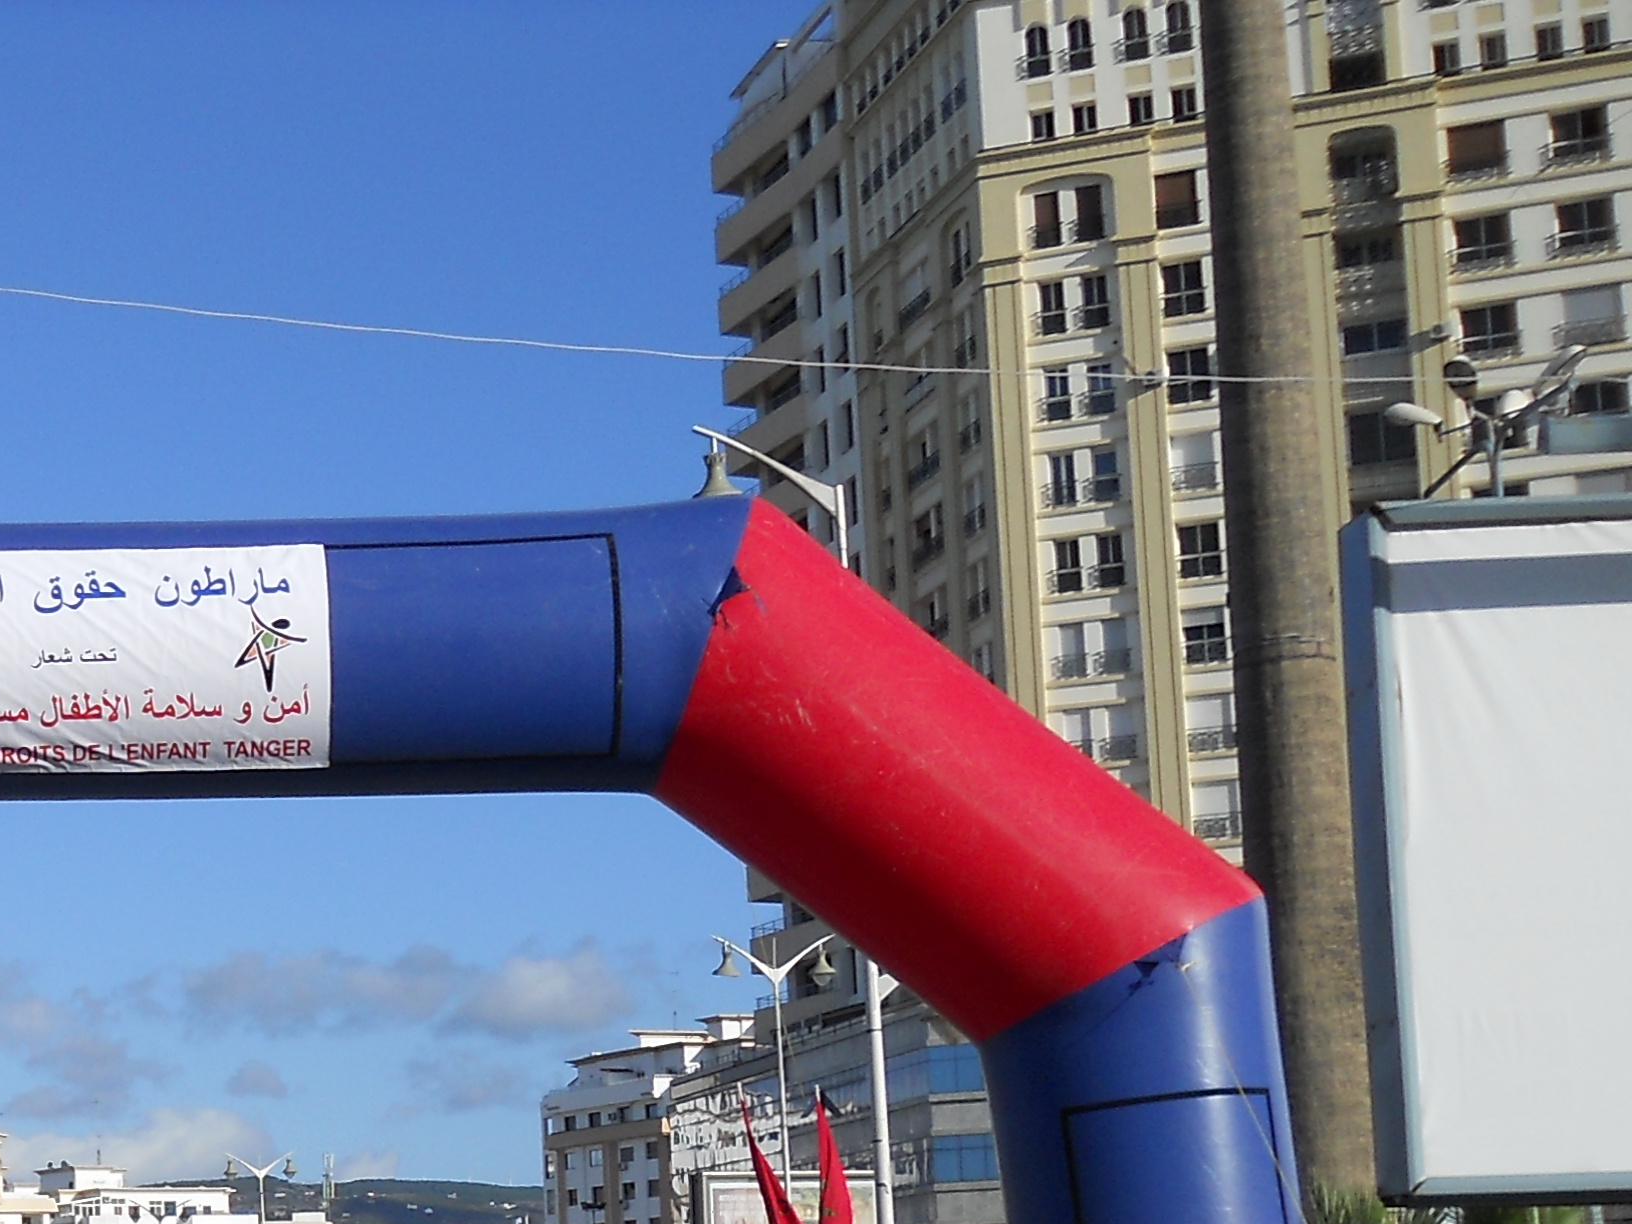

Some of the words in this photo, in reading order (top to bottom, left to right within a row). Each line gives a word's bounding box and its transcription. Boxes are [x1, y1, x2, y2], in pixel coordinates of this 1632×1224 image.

[33, 570, 126, 613] حقوق
[154, 566, 291, 607] ماراطون
[31, 647, 73, 669] شعار
[79, 648, 117, 663] تحت
[40, 688, 130, 727] الأطفال
[142, 688, 222, 720] سلامة
[233, 701, 252, 724] و
[263, 683, 310, 723] أمن
[73, 744, 100, 763] DE
[109, 741, 211, 761] L'ENFANT
[223, 739, 311, 758] TANGER
